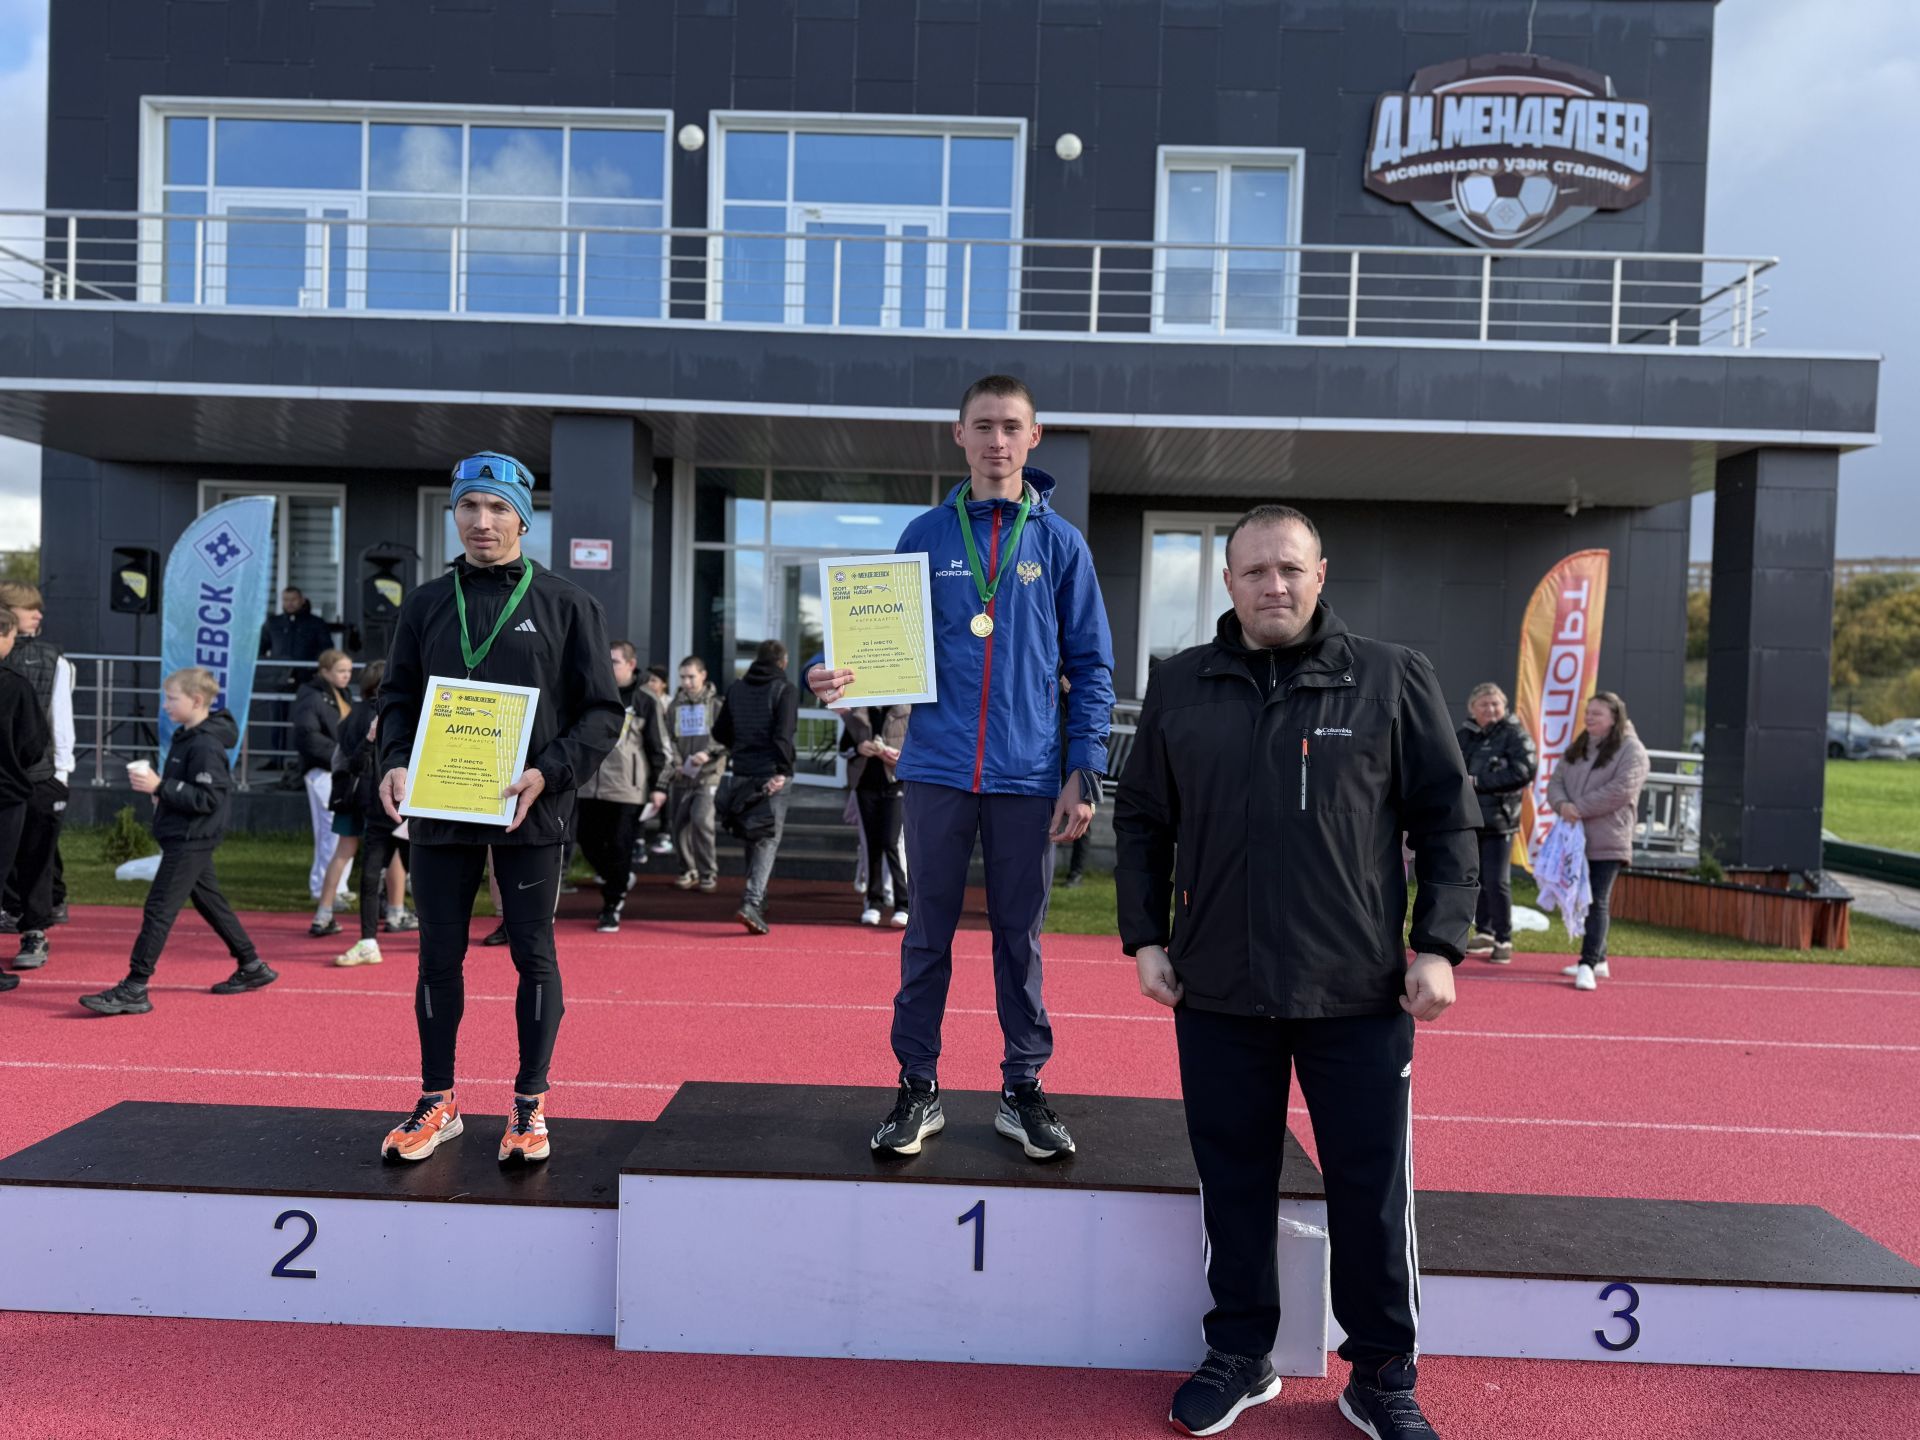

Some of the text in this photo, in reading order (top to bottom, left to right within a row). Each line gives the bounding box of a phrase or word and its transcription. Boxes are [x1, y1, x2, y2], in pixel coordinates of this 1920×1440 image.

[1441, 96, 1649, 173] МЕНДЕЛЕЕВ
[1553, 160, 1631, 186] стадион
[849, 603, 904, 616] ДИПЛОМ
[445, 724, 501, 737] ДИПЛОМ
[272, 1210, 317, 1278] 2
[958, 1200, 985, 1271] 1
[1595, 1283, 1640, 1351] 3
